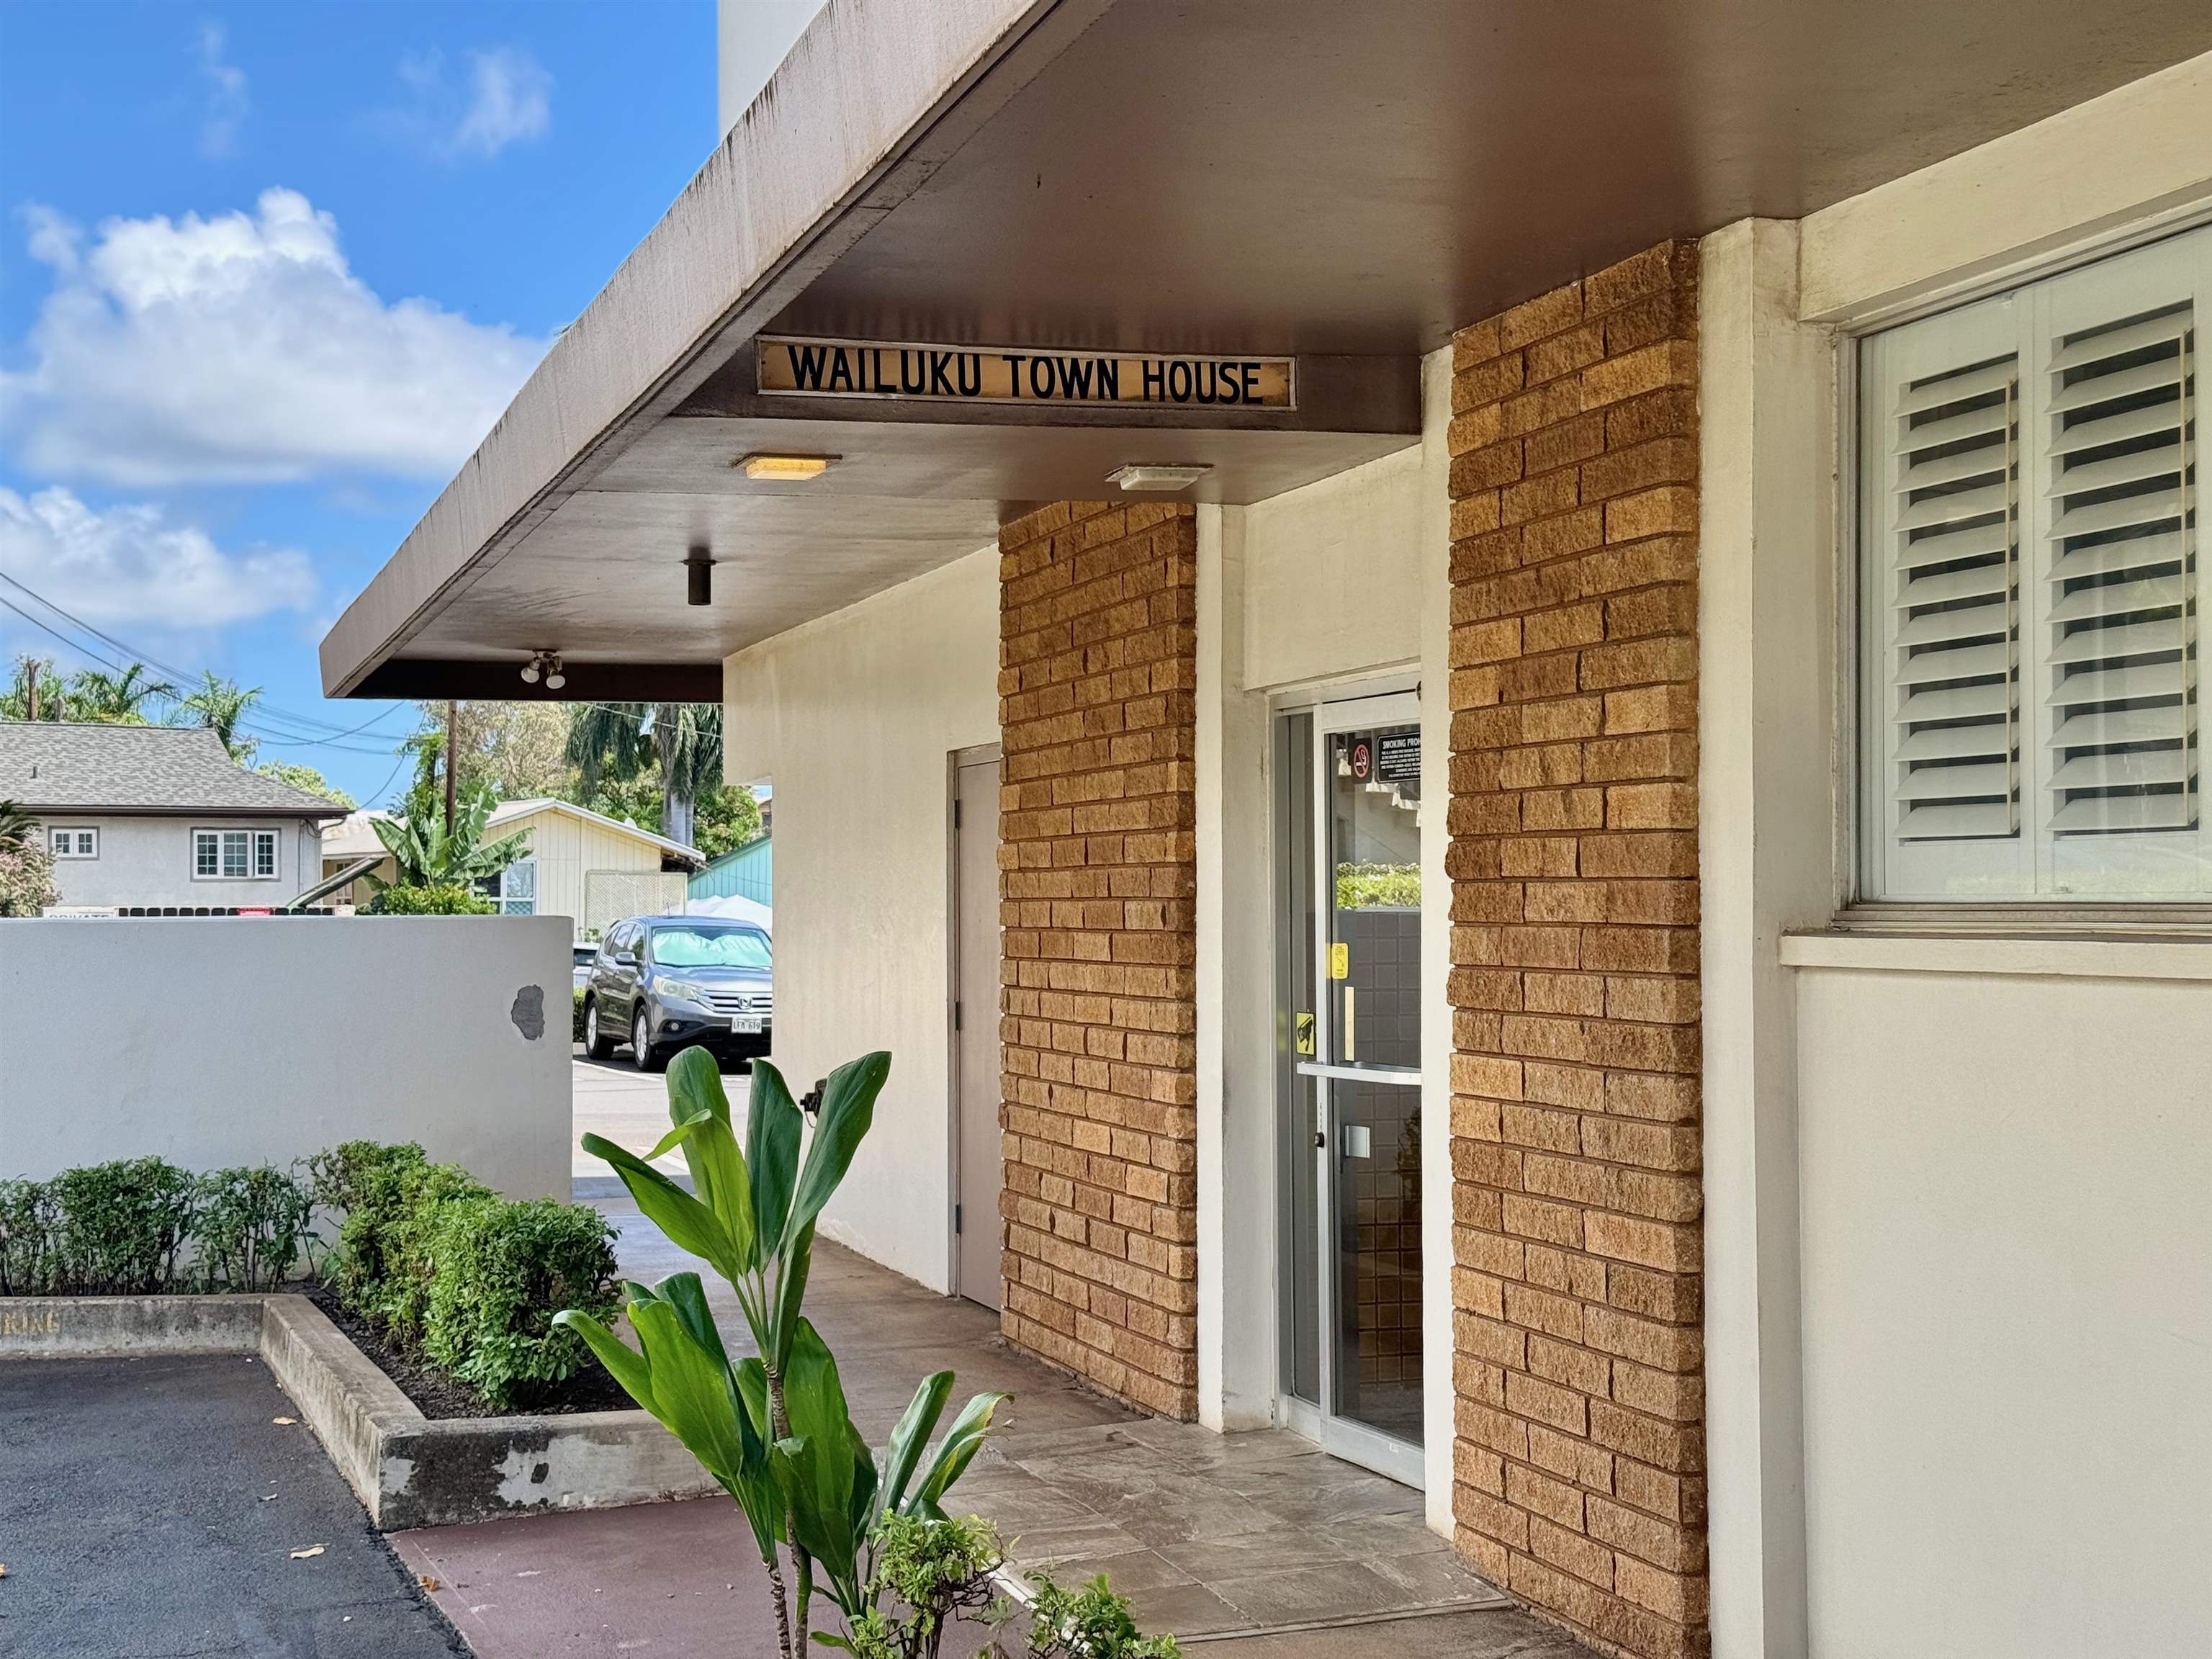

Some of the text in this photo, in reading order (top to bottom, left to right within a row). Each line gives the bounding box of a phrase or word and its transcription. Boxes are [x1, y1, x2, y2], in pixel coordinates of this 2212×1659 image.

[786, 344, 1264, 405] WAILUKU TOWN HOUSE
[1382, 738, 1406, 750] SMOKING
[0, 1311, 60, 1335] KING
